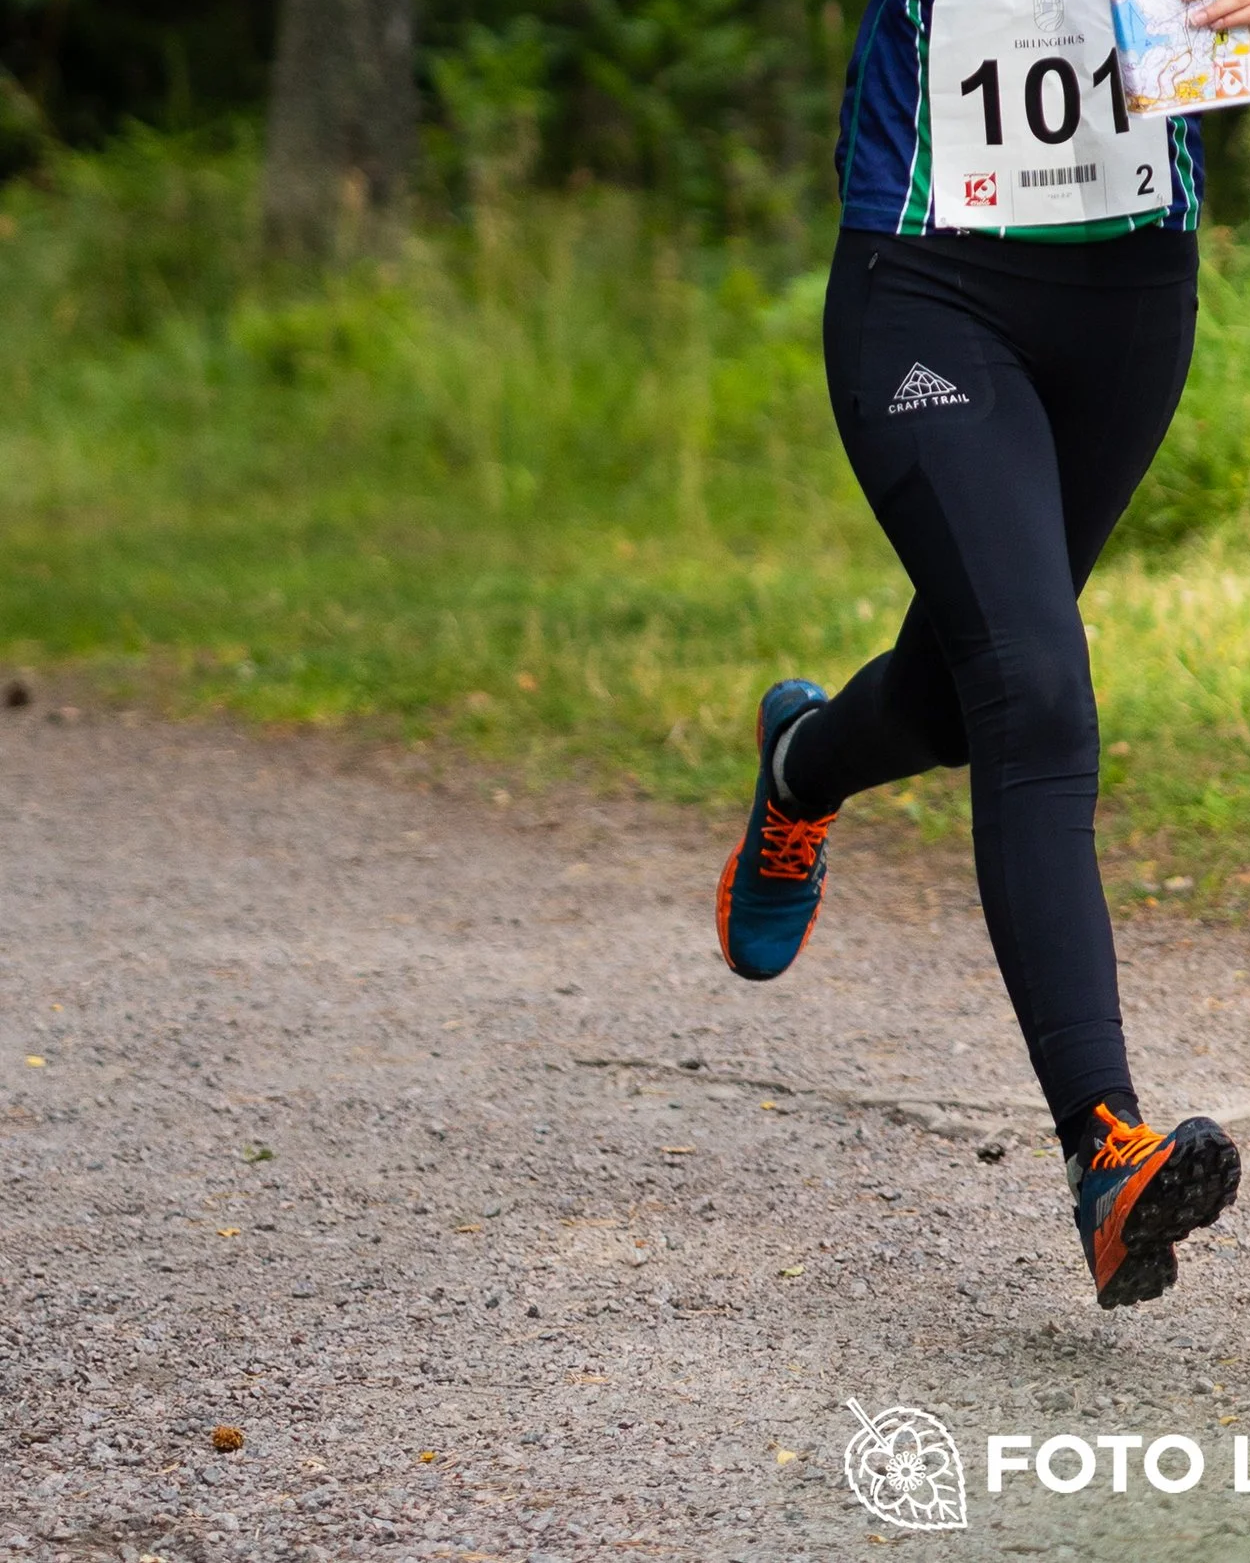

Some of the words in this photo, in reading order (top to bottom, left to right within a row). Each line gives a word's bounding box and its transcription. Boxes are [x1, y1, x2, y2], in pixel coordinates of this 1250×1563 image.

[960, 46, 1131, 146] 101
[1136, 163, 1155, 196] 2
[888, 398, 928, 414] CRAFT
[932, 393, 970, 406] TRAIL
